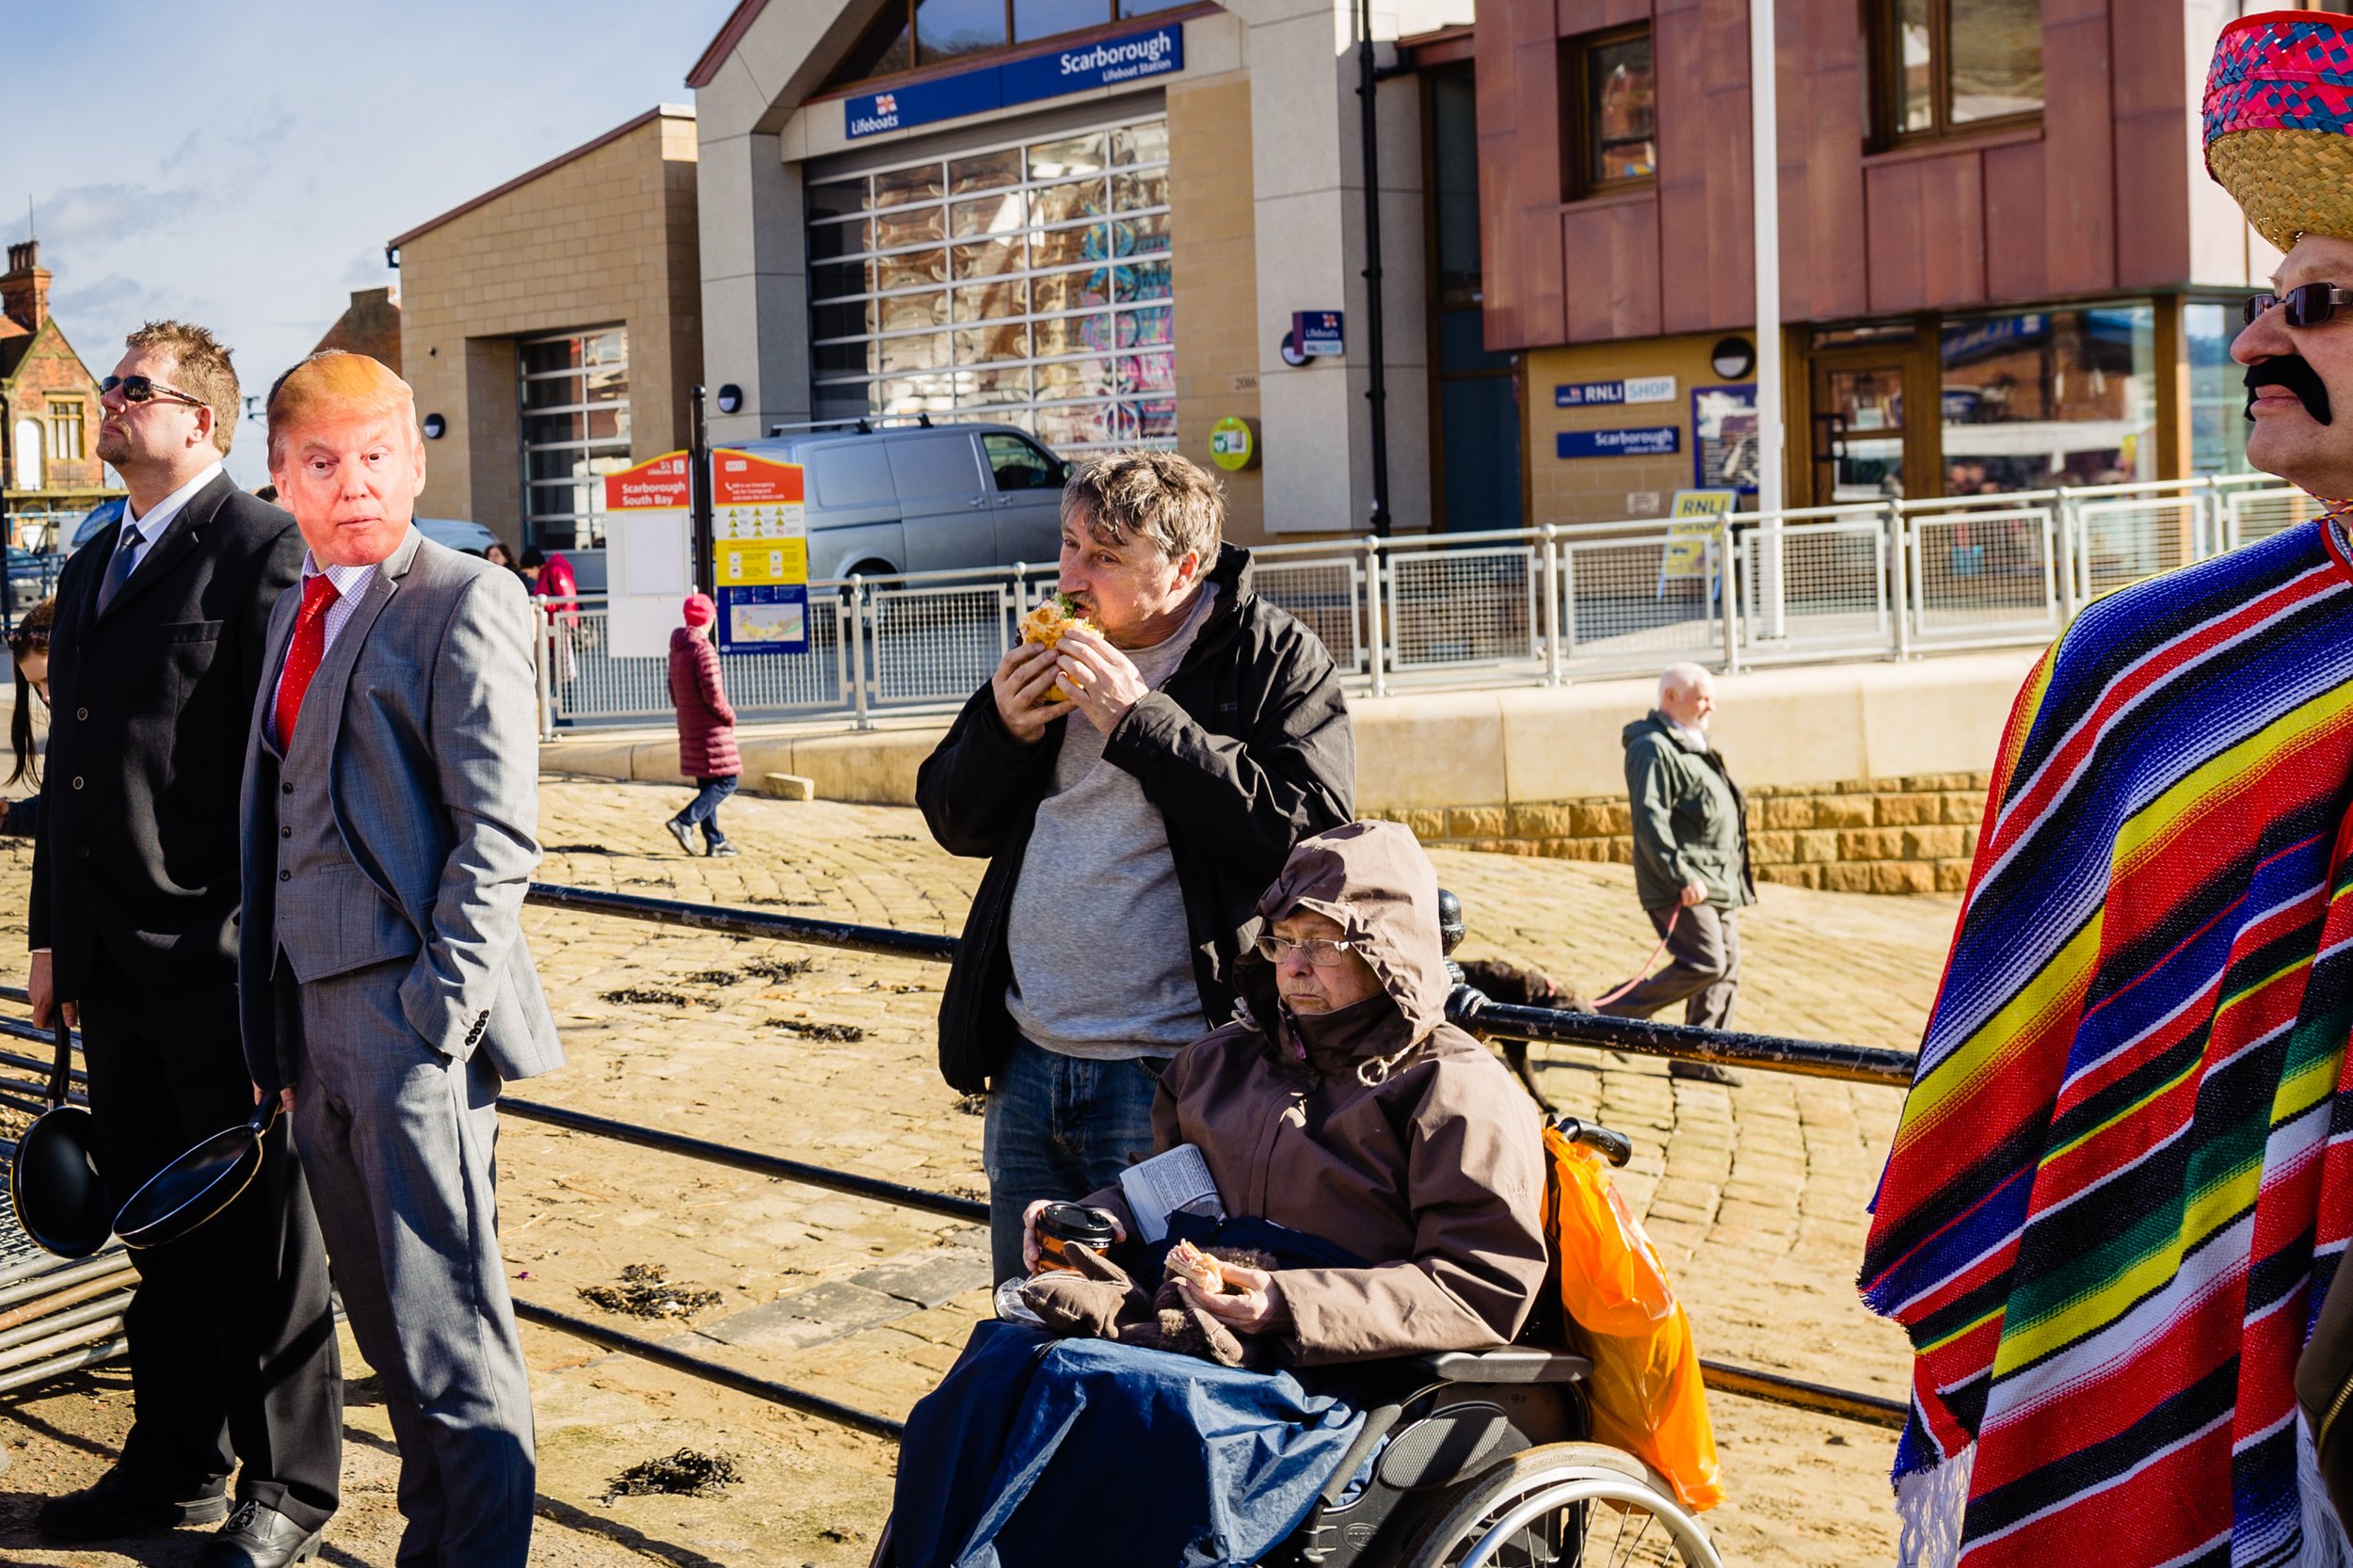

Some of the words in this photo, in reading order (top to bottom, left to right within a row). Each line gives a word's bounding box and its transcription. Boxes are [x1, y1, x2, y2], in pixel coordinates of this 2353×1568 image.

[1060, 30, 1172, 75] Scarborough
[1102, 65, 1138, 83] Lifeboat
[1139, 58, 1173, 75] Station
[851, 114, 899, 135] Lifeboats
[1305, 327, 1338, 339] Lifeboats
[1585, 383, 1623, 403] RNLI
[1628, 380, 1670, 400] SHOP
[1593, 427, 1673, 447] Scarborough
[621, 481, 685, 495] Scarborough
[622, 495, 652, 506] South
[654, 494, 674, 506] Bay
[1682, 497, 1727, 515] RNLI
